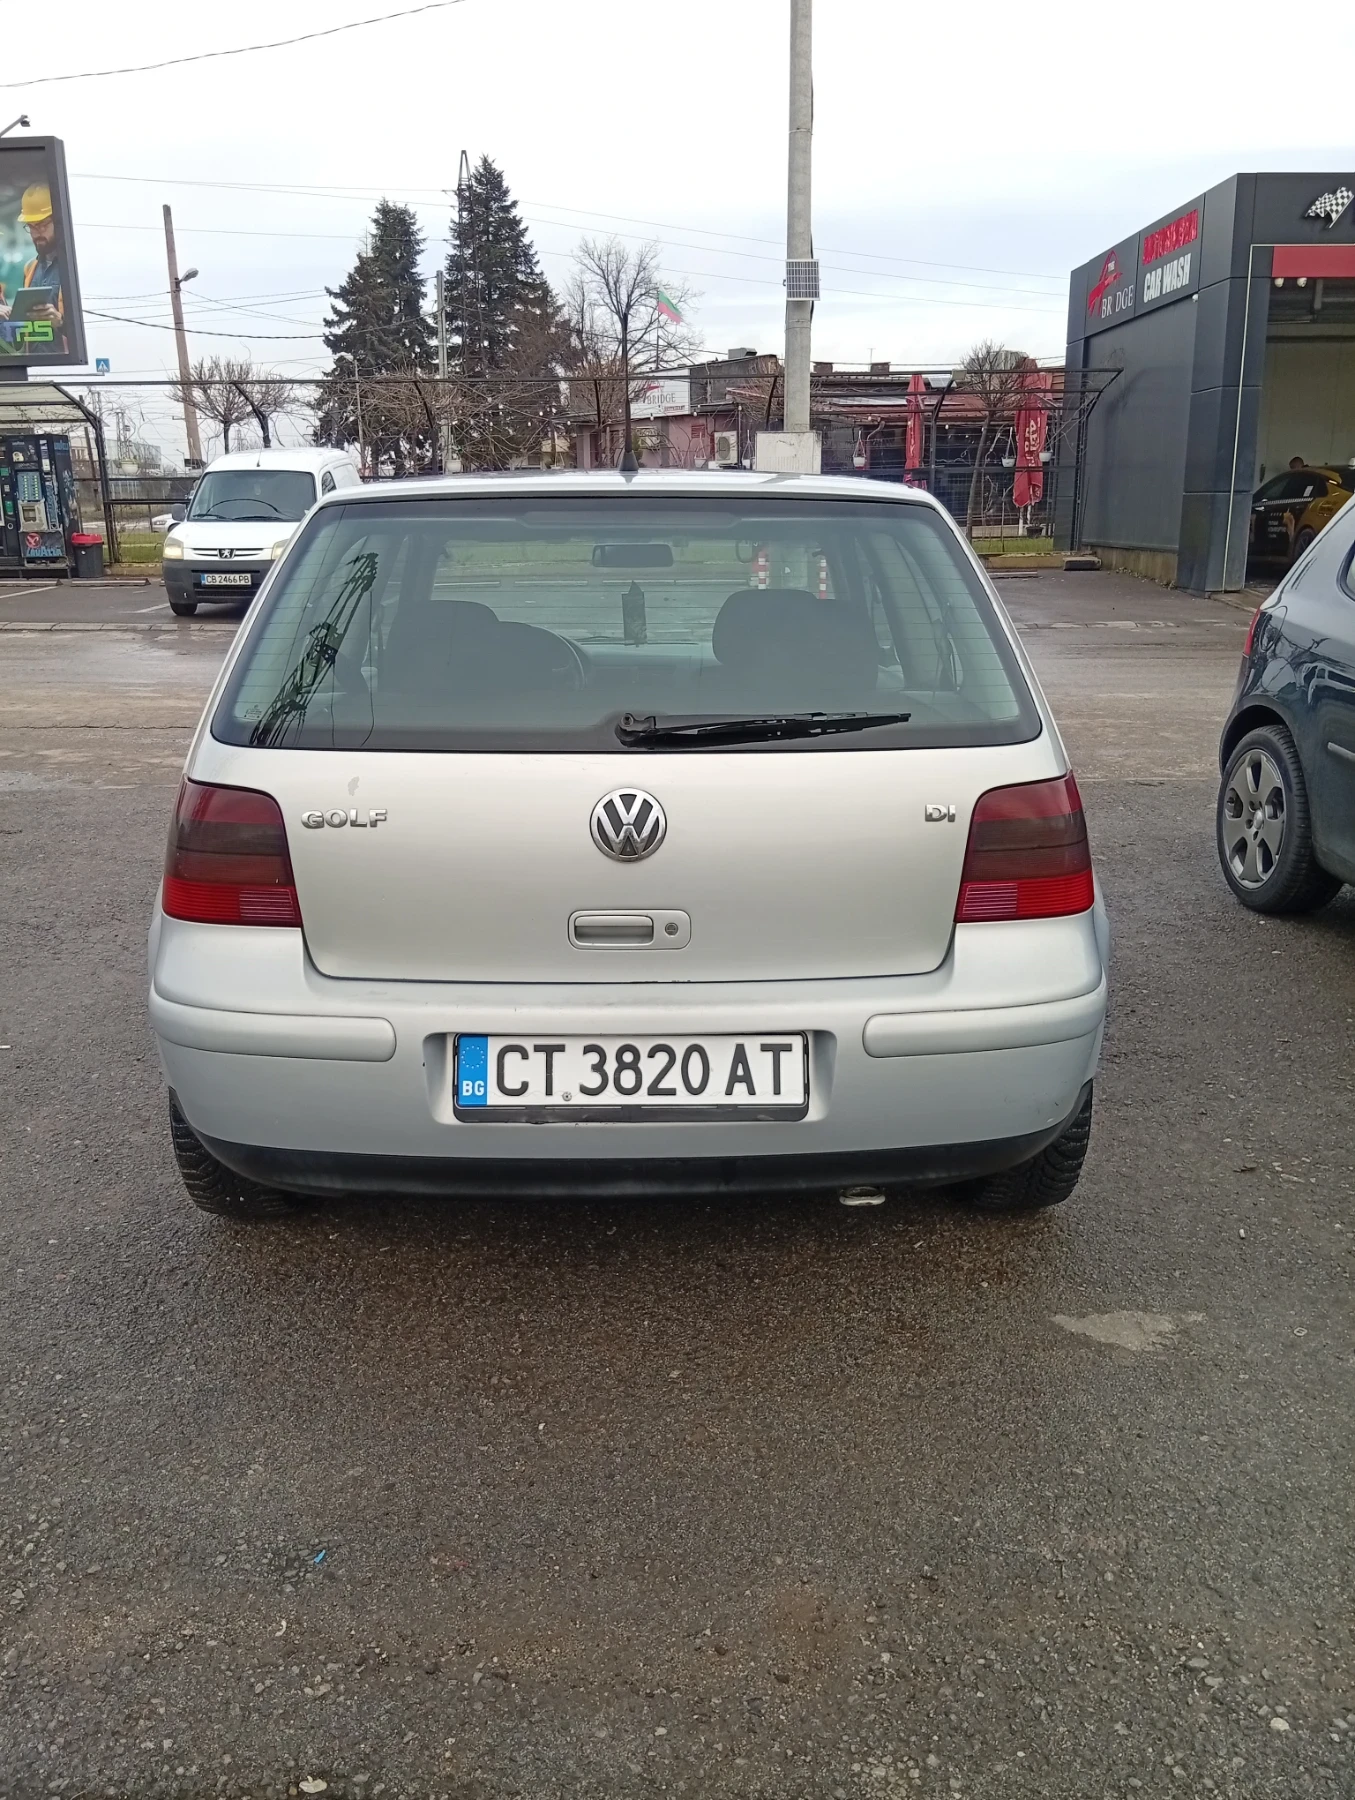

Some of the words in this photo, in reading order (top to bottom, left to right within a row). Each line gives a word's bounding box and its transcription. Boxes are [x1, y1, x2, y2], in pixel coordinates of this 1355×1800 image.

[1143, 267, 1162, 303] CAR
[1162, 252, 1192, 295] WASH
[1101, 284, 1134, 319] BRDGE
[206, 575, 217, 584] CB
[218, 575, 238, 584] 2466
[238, 575, 250, 584] PB
[301, 808, 388, 830] GOLF
[924, 804, 956, 823] DI
[496, 1043, 566, 1097] CT
[579, 1043, 711, 1096] 3820
[724, 1042, 793, 1096] AT
[462, 1080, 486, 1097] BG
